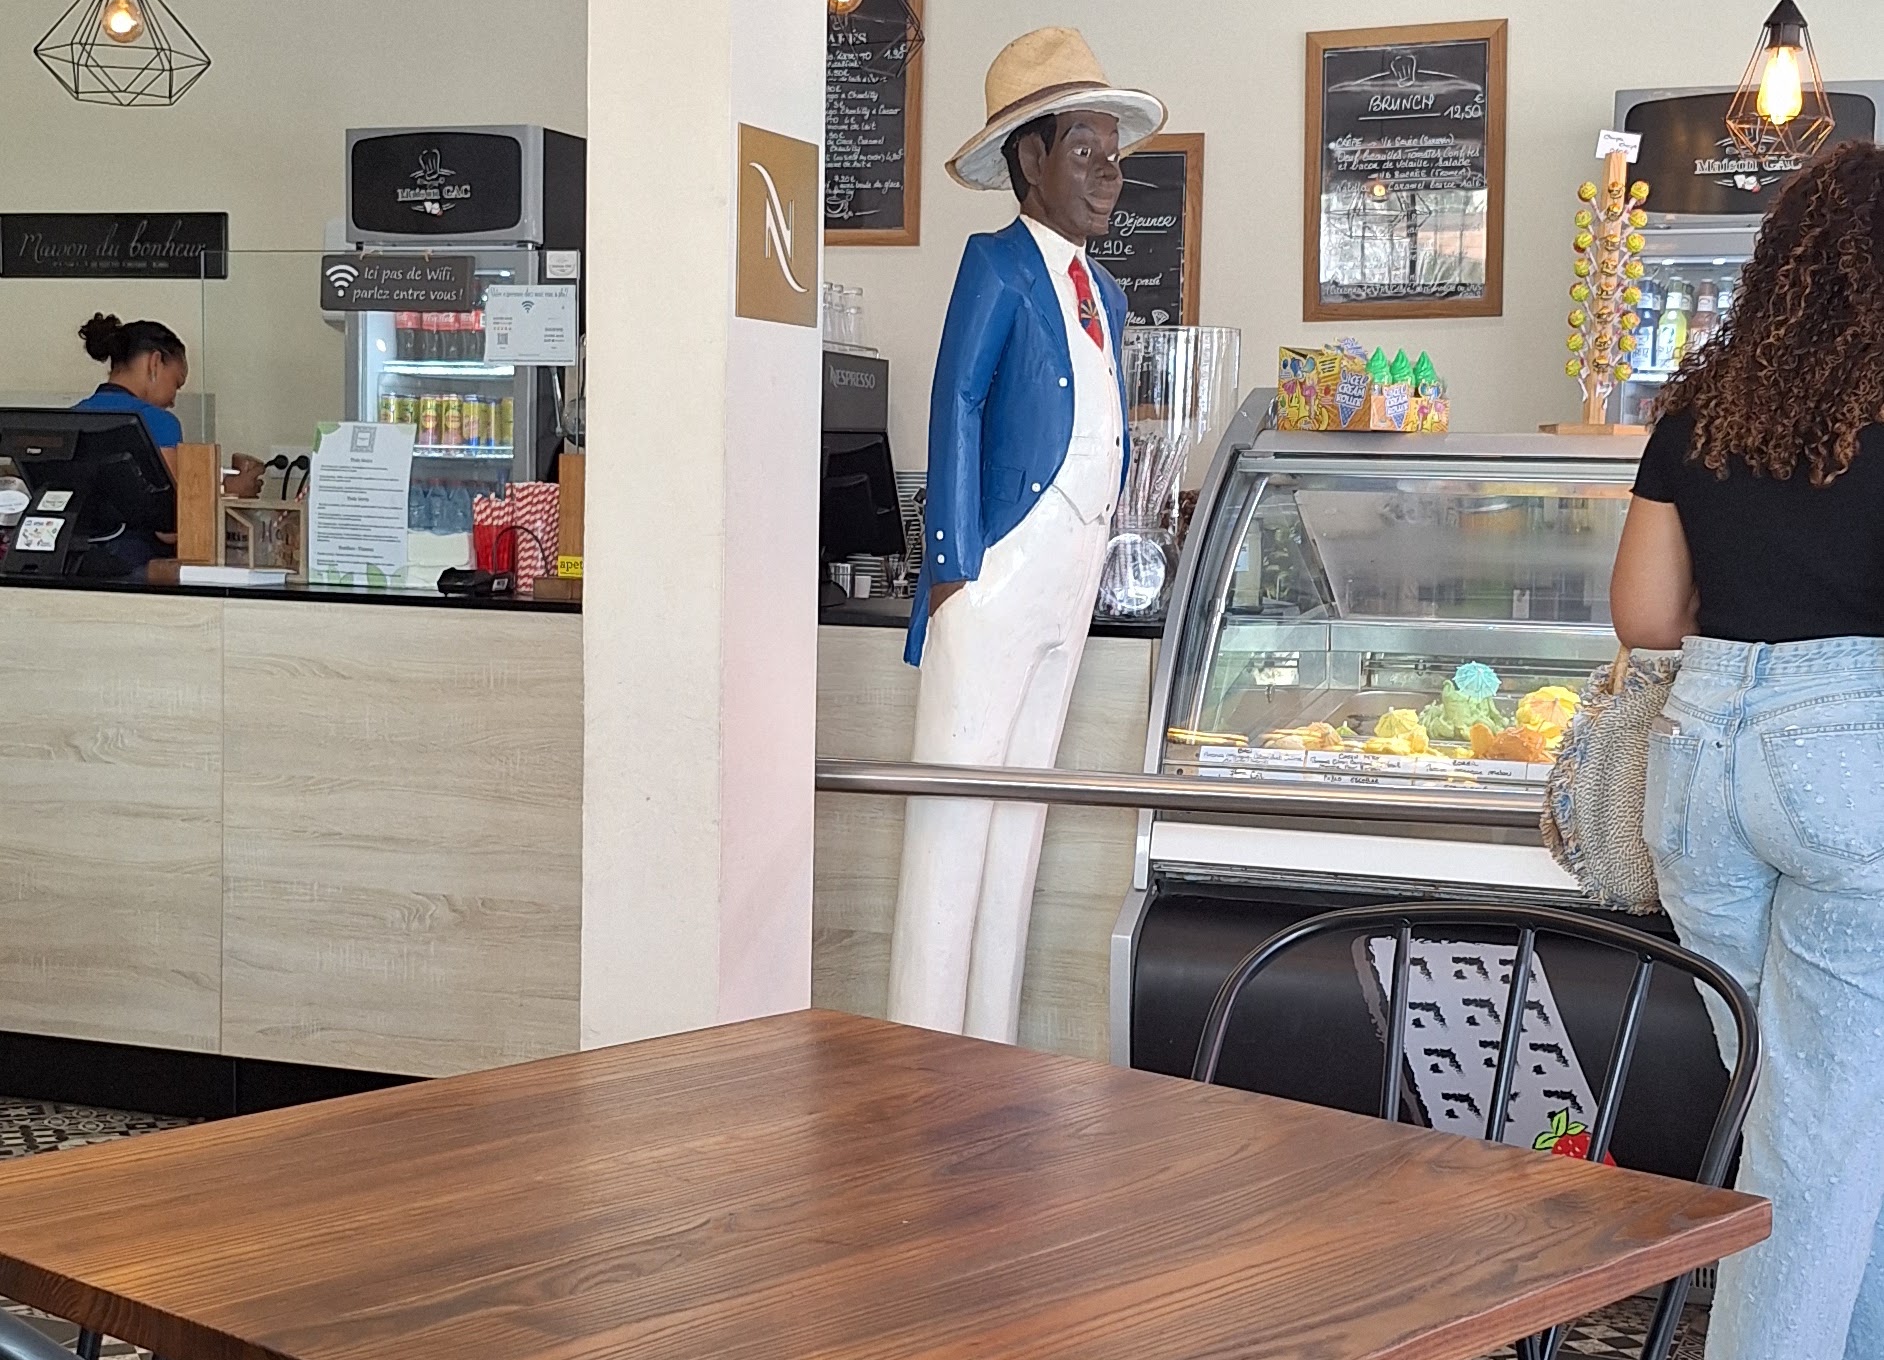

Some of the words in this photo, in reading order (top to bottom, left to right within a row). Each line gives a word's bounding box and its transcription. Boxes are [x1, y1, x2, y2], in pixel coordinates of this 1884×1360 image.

[1368, 93, 1435, 112] BRUNCH
[1694, 158, 1758, 174] Maison
[19, 232, 88, 263] Maison
[96, 223, 119, 257] du
[130, 219, 207, 257] bonheur
[364, 265, 379, 279] Ici
[381, 270, 402, 284] pas
[406, 266, 422, 280] de
[352, 286, 390, 302] parlez
[393, 288, 426, 300] entre
[830, 365, 876, 389] NESPRESSO
